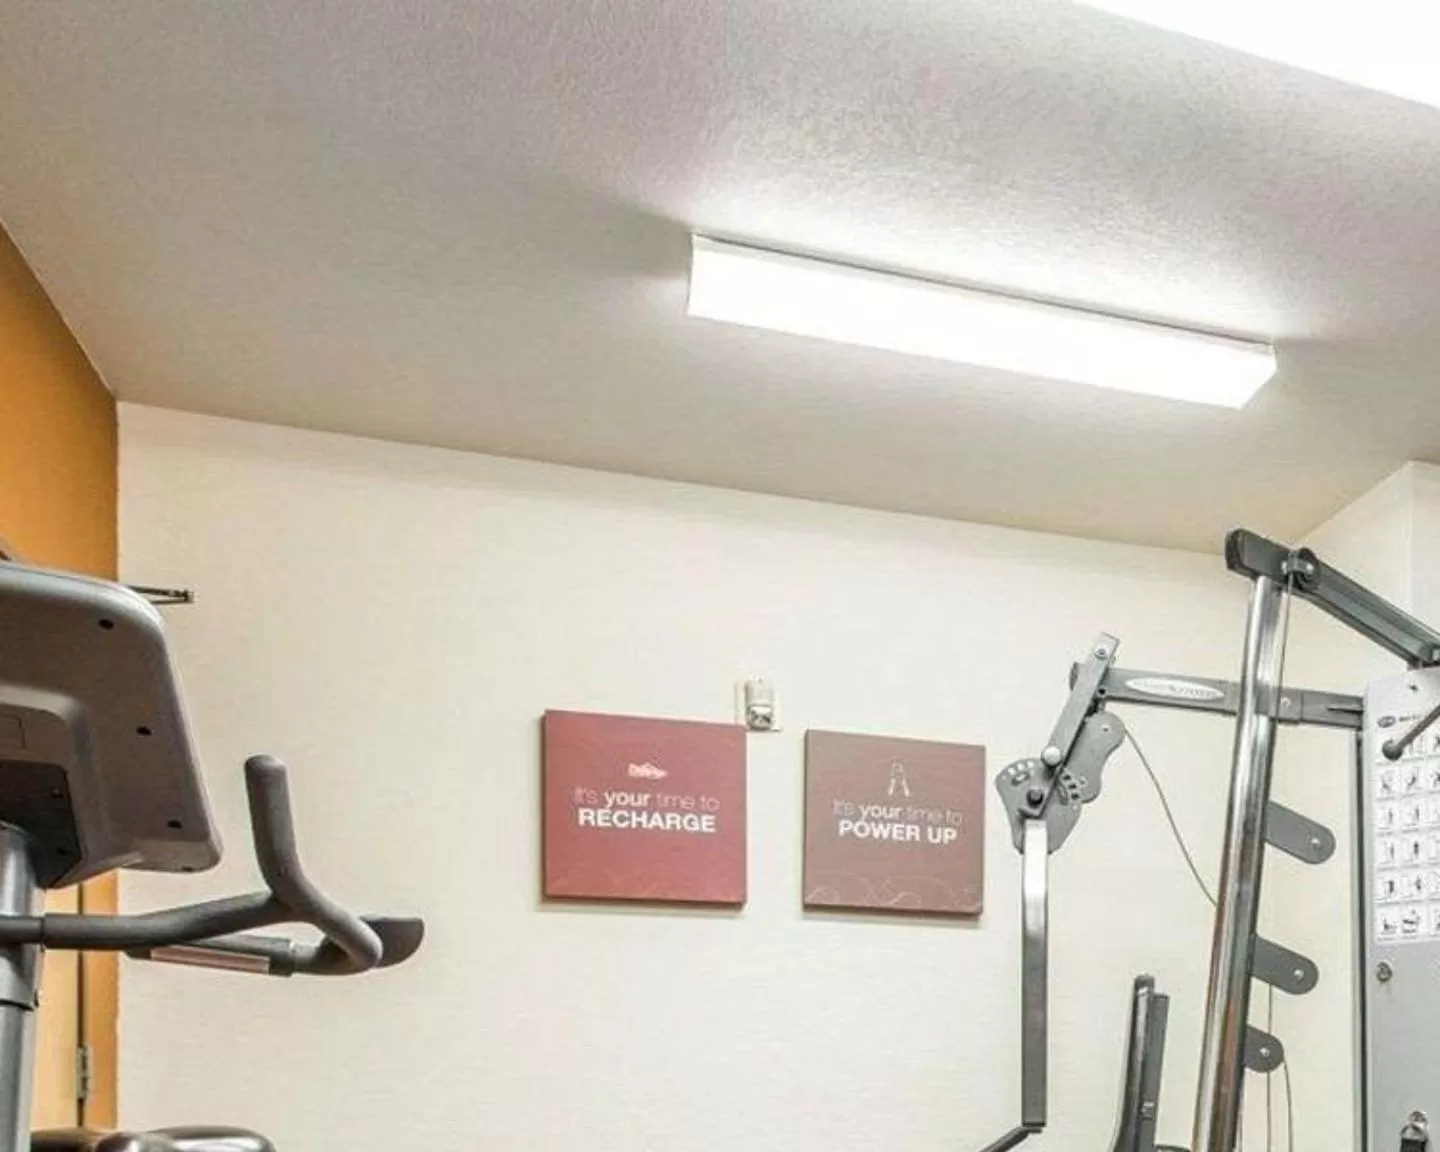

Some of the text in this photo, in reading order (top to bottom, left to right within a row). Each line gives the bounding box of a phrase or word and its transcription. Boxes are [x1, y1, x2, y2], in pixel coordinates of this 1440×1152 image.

[604, 791, 651, 808] your
[699, 795, 720, 812] to
[858, 804, 903, 821] your
[578, 807, 717, 833] RECHARGE
[839, 819, 957, 844] POWER UP
